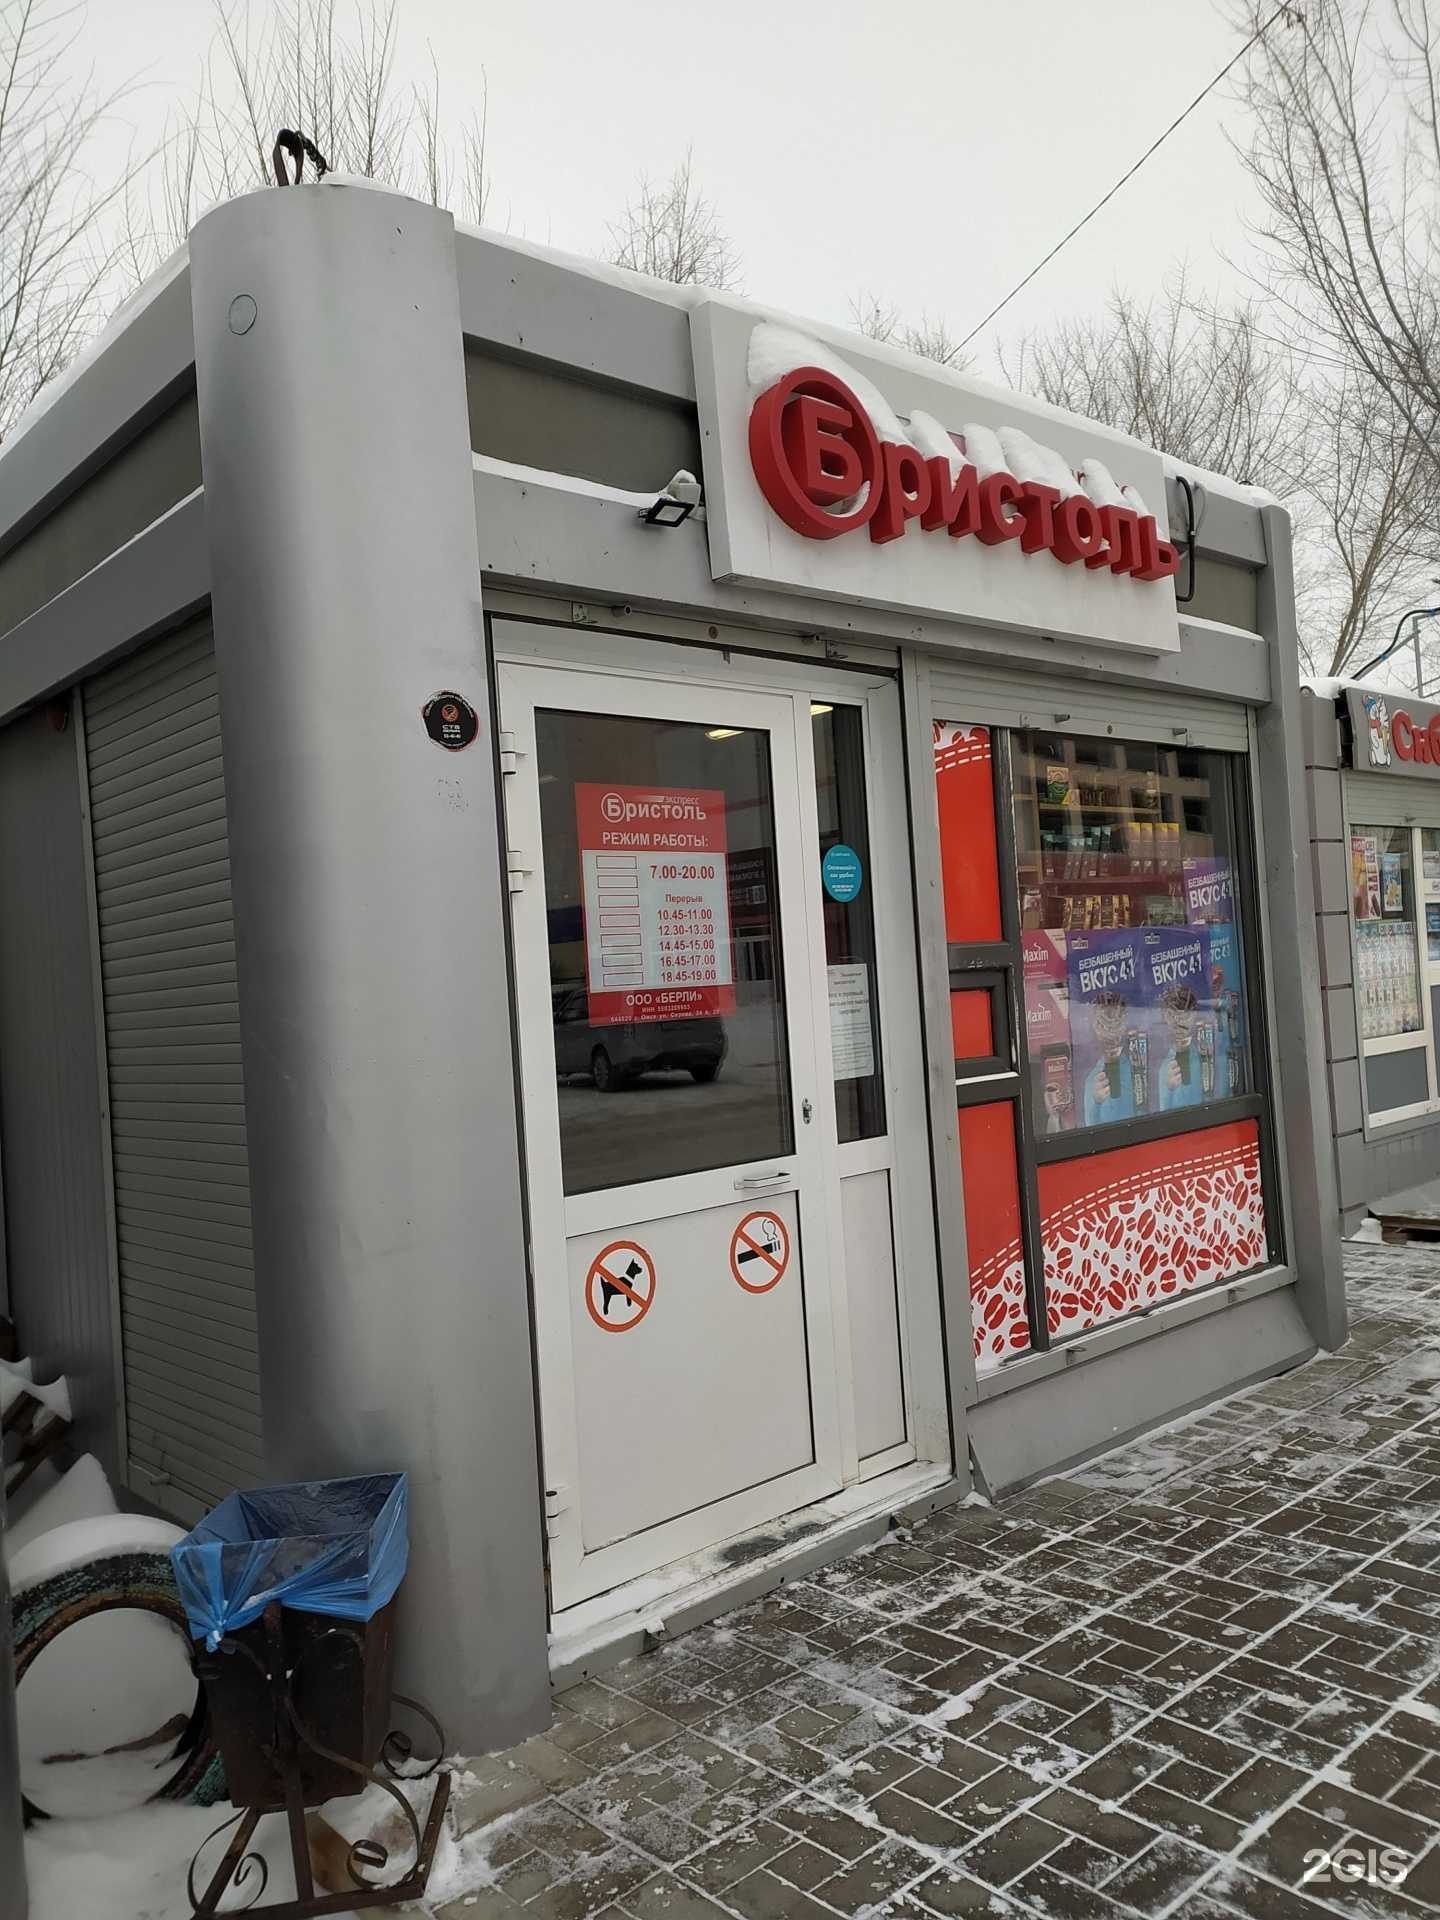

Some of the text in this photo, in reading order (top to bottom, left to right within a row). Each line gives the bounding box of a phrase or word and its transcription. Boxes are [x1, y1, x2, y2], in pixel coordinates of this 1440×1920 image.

[749, 367, 1180, 582] Бристоль
[601, 792, 707, 823] Бристоль
[602, 832, 709, 847] РЕЖИМ РАБОТЫ:
[650, 864, 715, 880] 7.00-20.00
[665, 893, 703, 905] Перерыв
[1189, 884, 1220, 909] ВКУС
[657, 908, 712, 921] 10.45-11.00
[658, 924, 714, 936] 12.30-13.30
[659, 939, 715, 952] 14.45-15.00
[1151, 940, 1201, 964] БЕЗБАШЕННЫЙ
[660, 954, 716, 967] 16.45-17.00
[1079, 945, 1133, 970] БЕЗБАШЕННЫЙ
[661, 970, 717, 983] 18.45-19.00
[1080, 961, 1118, 993] ВКУС
[1152, 958, 1187, 985] ВКУС
[626, 991, 702, 1006] ООО «БЕРЛИ»
